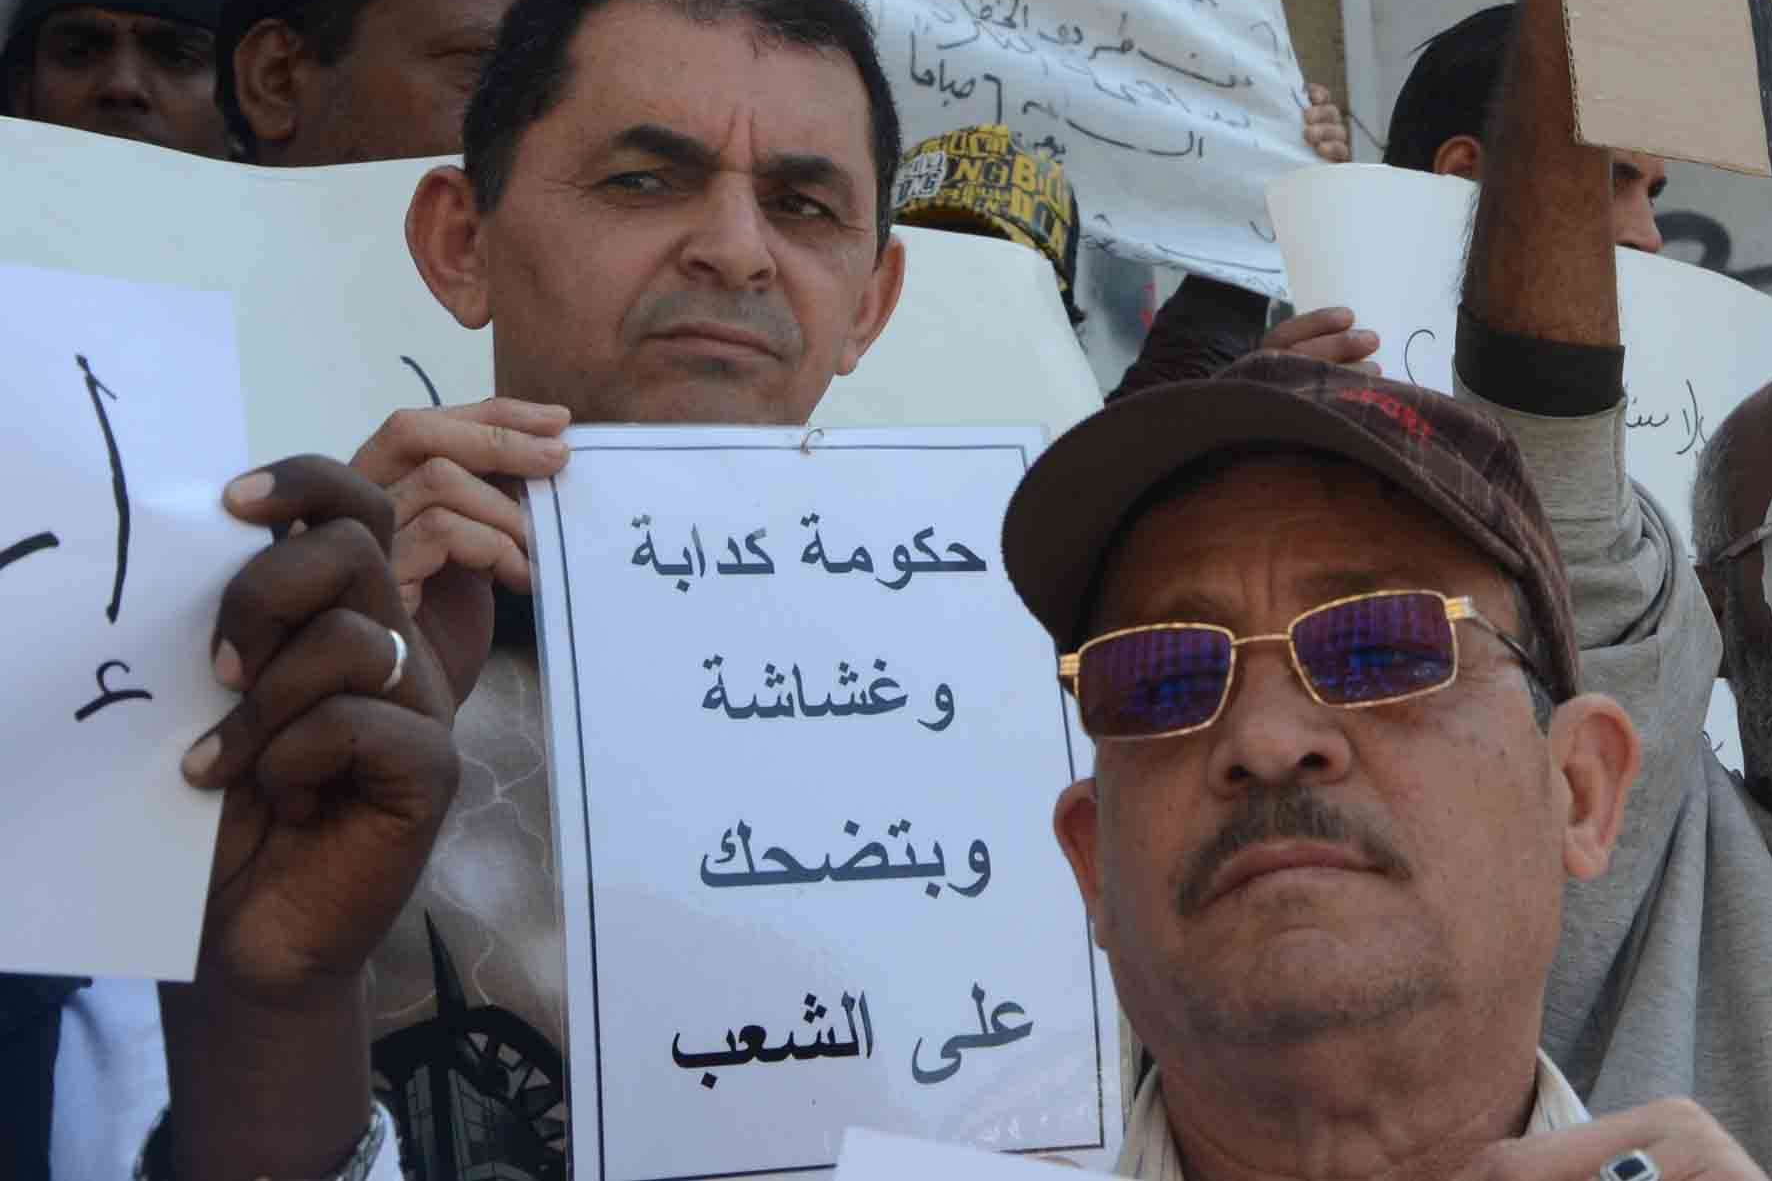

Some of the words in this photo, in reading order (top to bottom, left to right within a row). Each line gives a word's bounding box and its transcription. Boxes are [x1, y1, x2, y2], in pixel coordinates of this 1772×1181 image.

[630, 514, 775, 595] كدابة
[800, 512, 988, 591] حكومة
[702, 654, 955, 733] وغشاشة
[700, 819, 991, 899] وبتضحك
[672, 990, 874, 1090] الشعب
[912, 981, 1034, 1086] على
